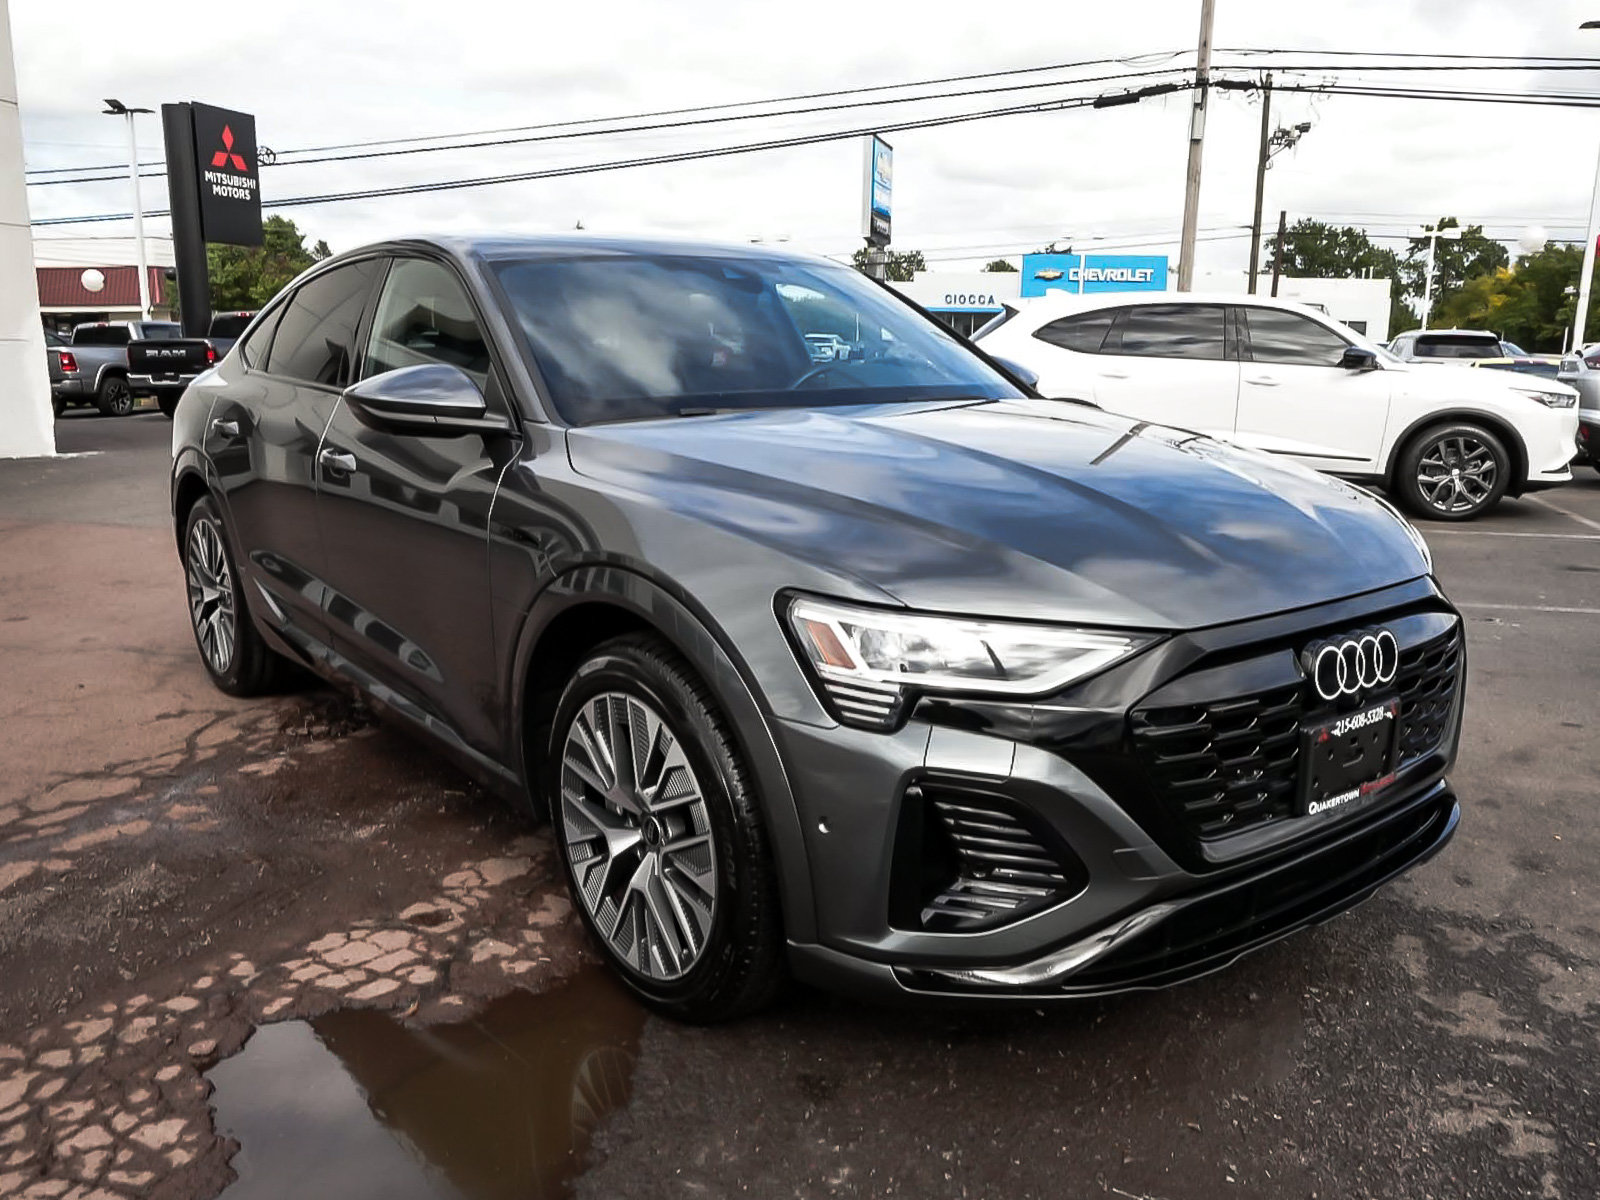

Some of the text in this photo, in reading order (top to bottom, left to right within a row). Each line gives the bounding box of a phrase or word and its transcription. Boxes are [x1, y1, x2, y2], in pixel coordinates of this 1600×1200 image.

[204, 170, 256, 190] MITSUBISHI
[212, 184, 251, 200] MOTORS
[945, 294, 995, 305] CIOCCA
[145, 349, 186, 357] RAM
[1335, 705, 1384, 734] 215-608-5328
[1308, 788, 1360, 815] QUAKERTOWN
